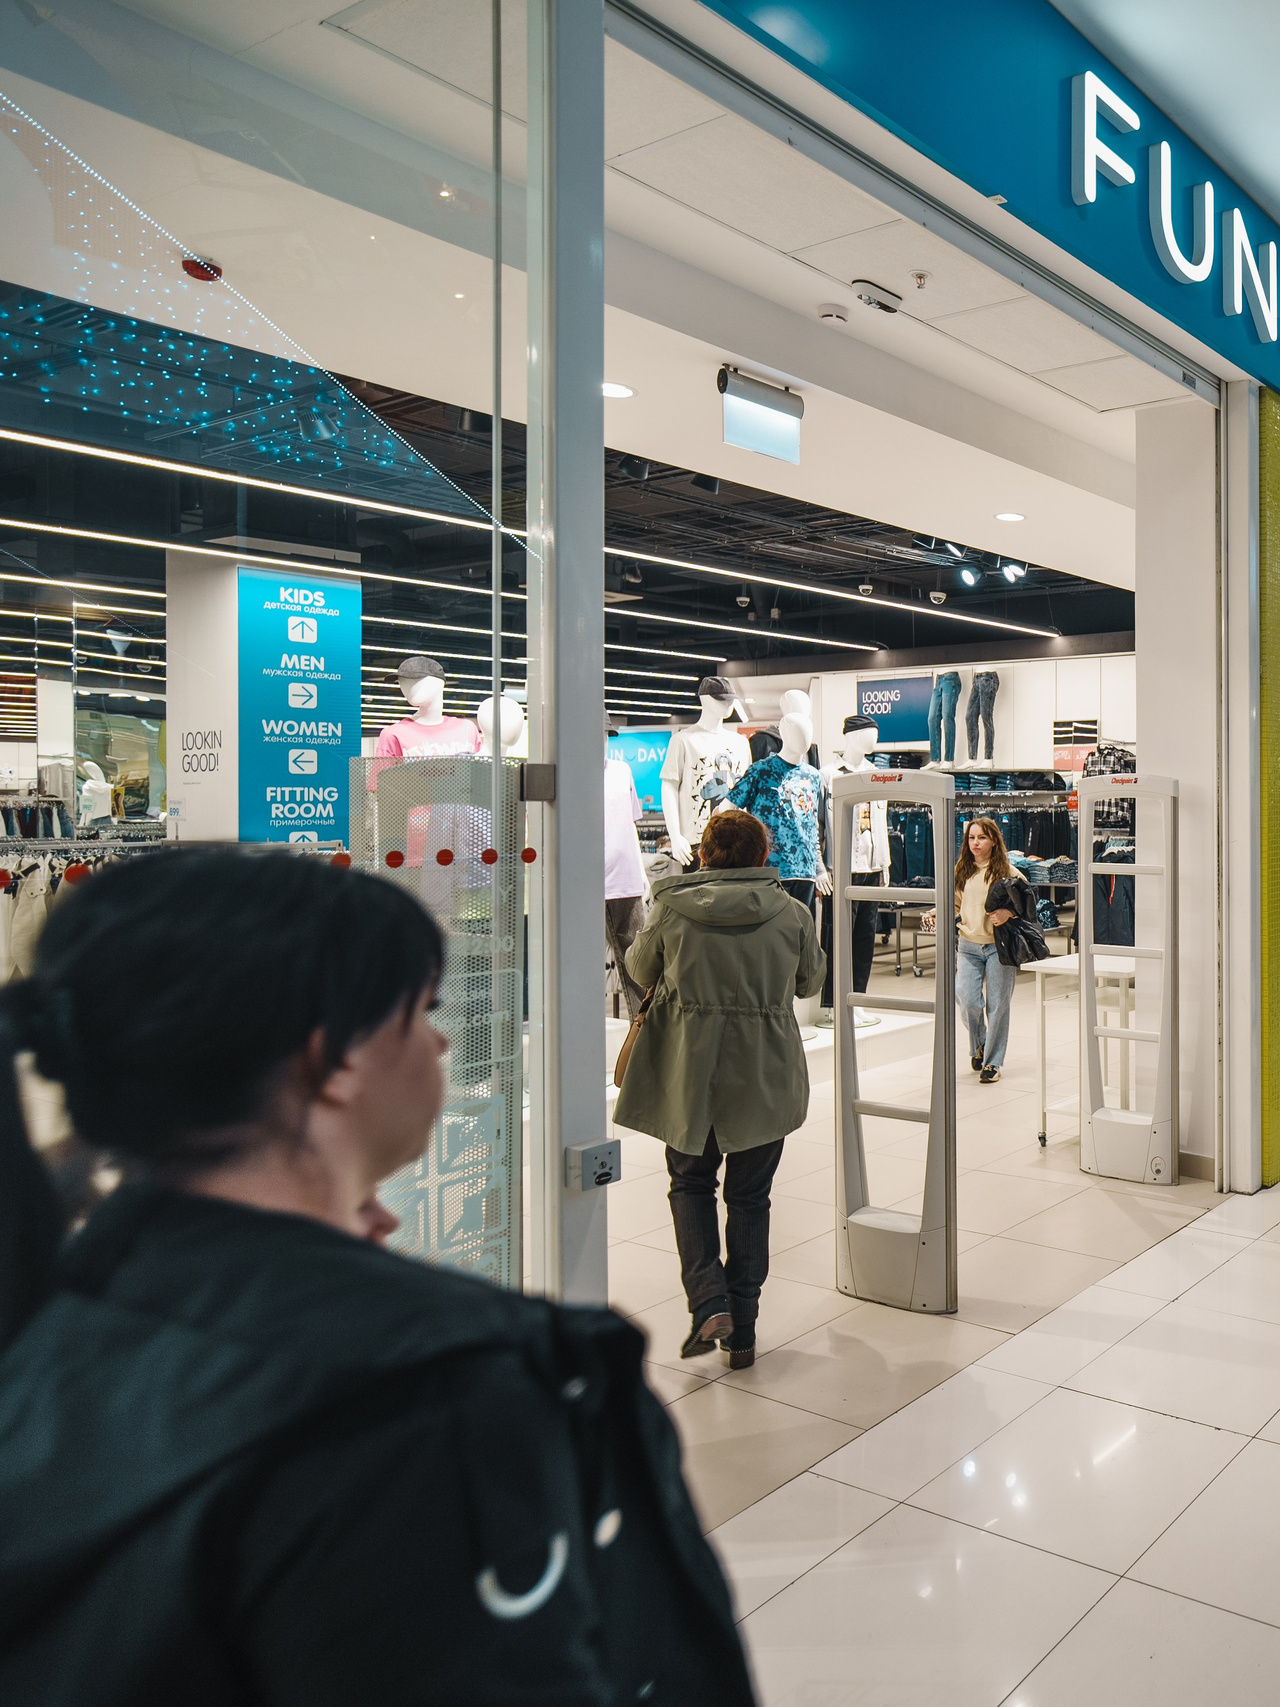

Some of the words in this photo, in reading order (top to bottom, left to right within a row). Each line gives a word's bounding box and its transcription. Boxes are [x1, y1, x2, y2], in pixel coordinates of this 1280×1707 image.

[1071, 70, 1280, 344] FUN
[279, 586, 326, 607] KIDS
[263, 601, 302, 612] детская
[303, 606, 340, 617] одежда
[280, 653, 326, 671] MEN
[262, 668, 304, 678] мужская
[305, 671, 342, 681] одежда
[862, 689, 901, 703] LOOKING
[862, 702, 892, 715] GOOD!
[261, 719, 342, 737] WOMEN
[181, 730, 222, 751] LOOKIN
[263, 735, 303, 743] женская
[305, 737, 341, 745] одежда
[182, 753, 219, 773] GOOD!
[637, 747, 666, 763] DAY
[266, 787, 339, 802] FITTING
[271, 803, 334, 818] ROOM
[270, 819, 335, 828] примерочные
